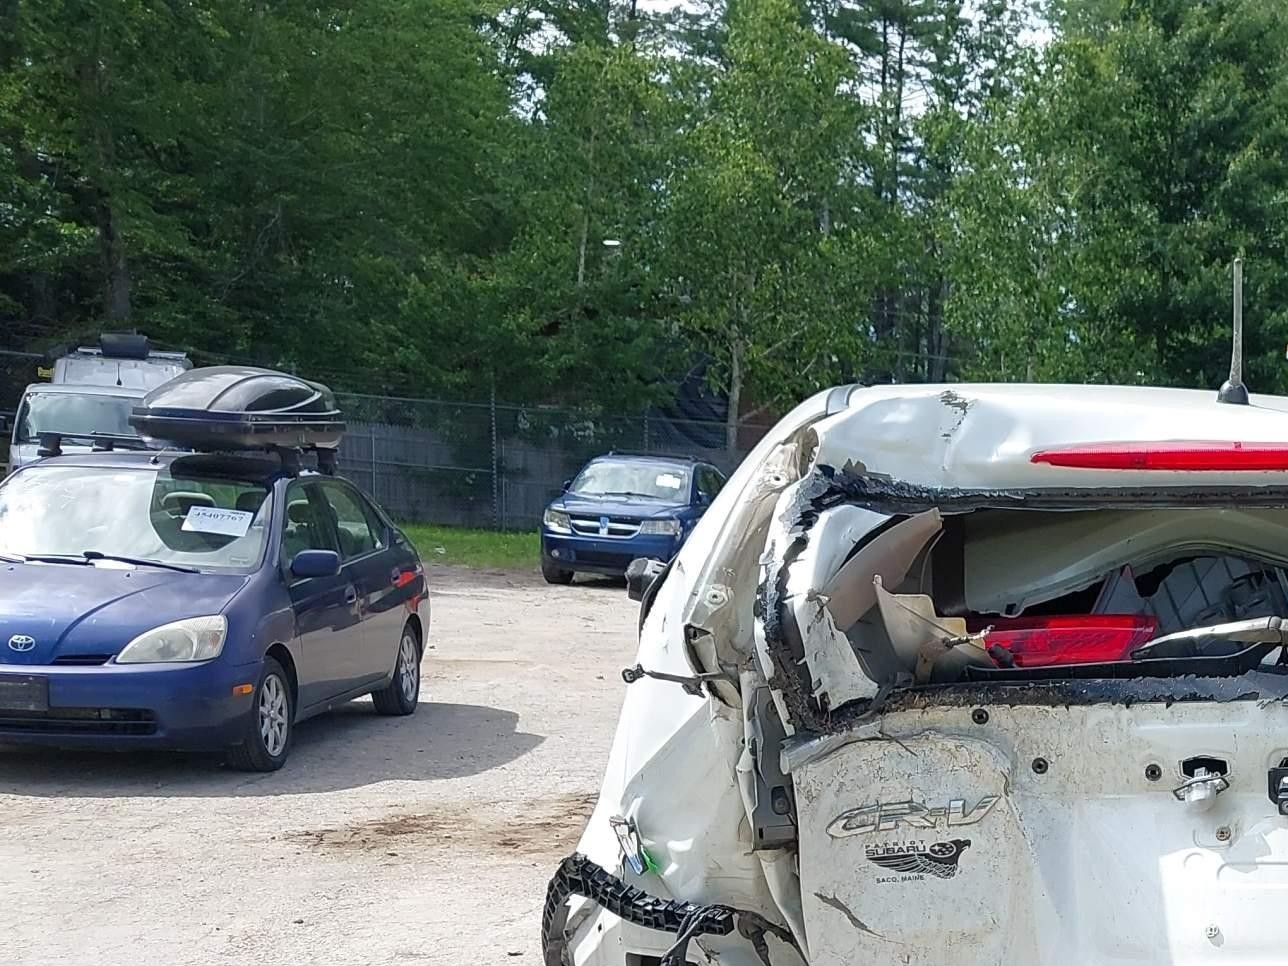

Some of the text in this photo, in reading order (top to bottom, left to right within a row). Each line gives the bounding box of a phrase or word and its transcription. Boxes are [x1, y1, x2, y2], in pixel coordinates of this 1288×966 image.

[826, 796, 1001, 839] CR-V
[865, 840, 925, 849] PATRIOT
[865, 845, 927, 857] SUBARU
